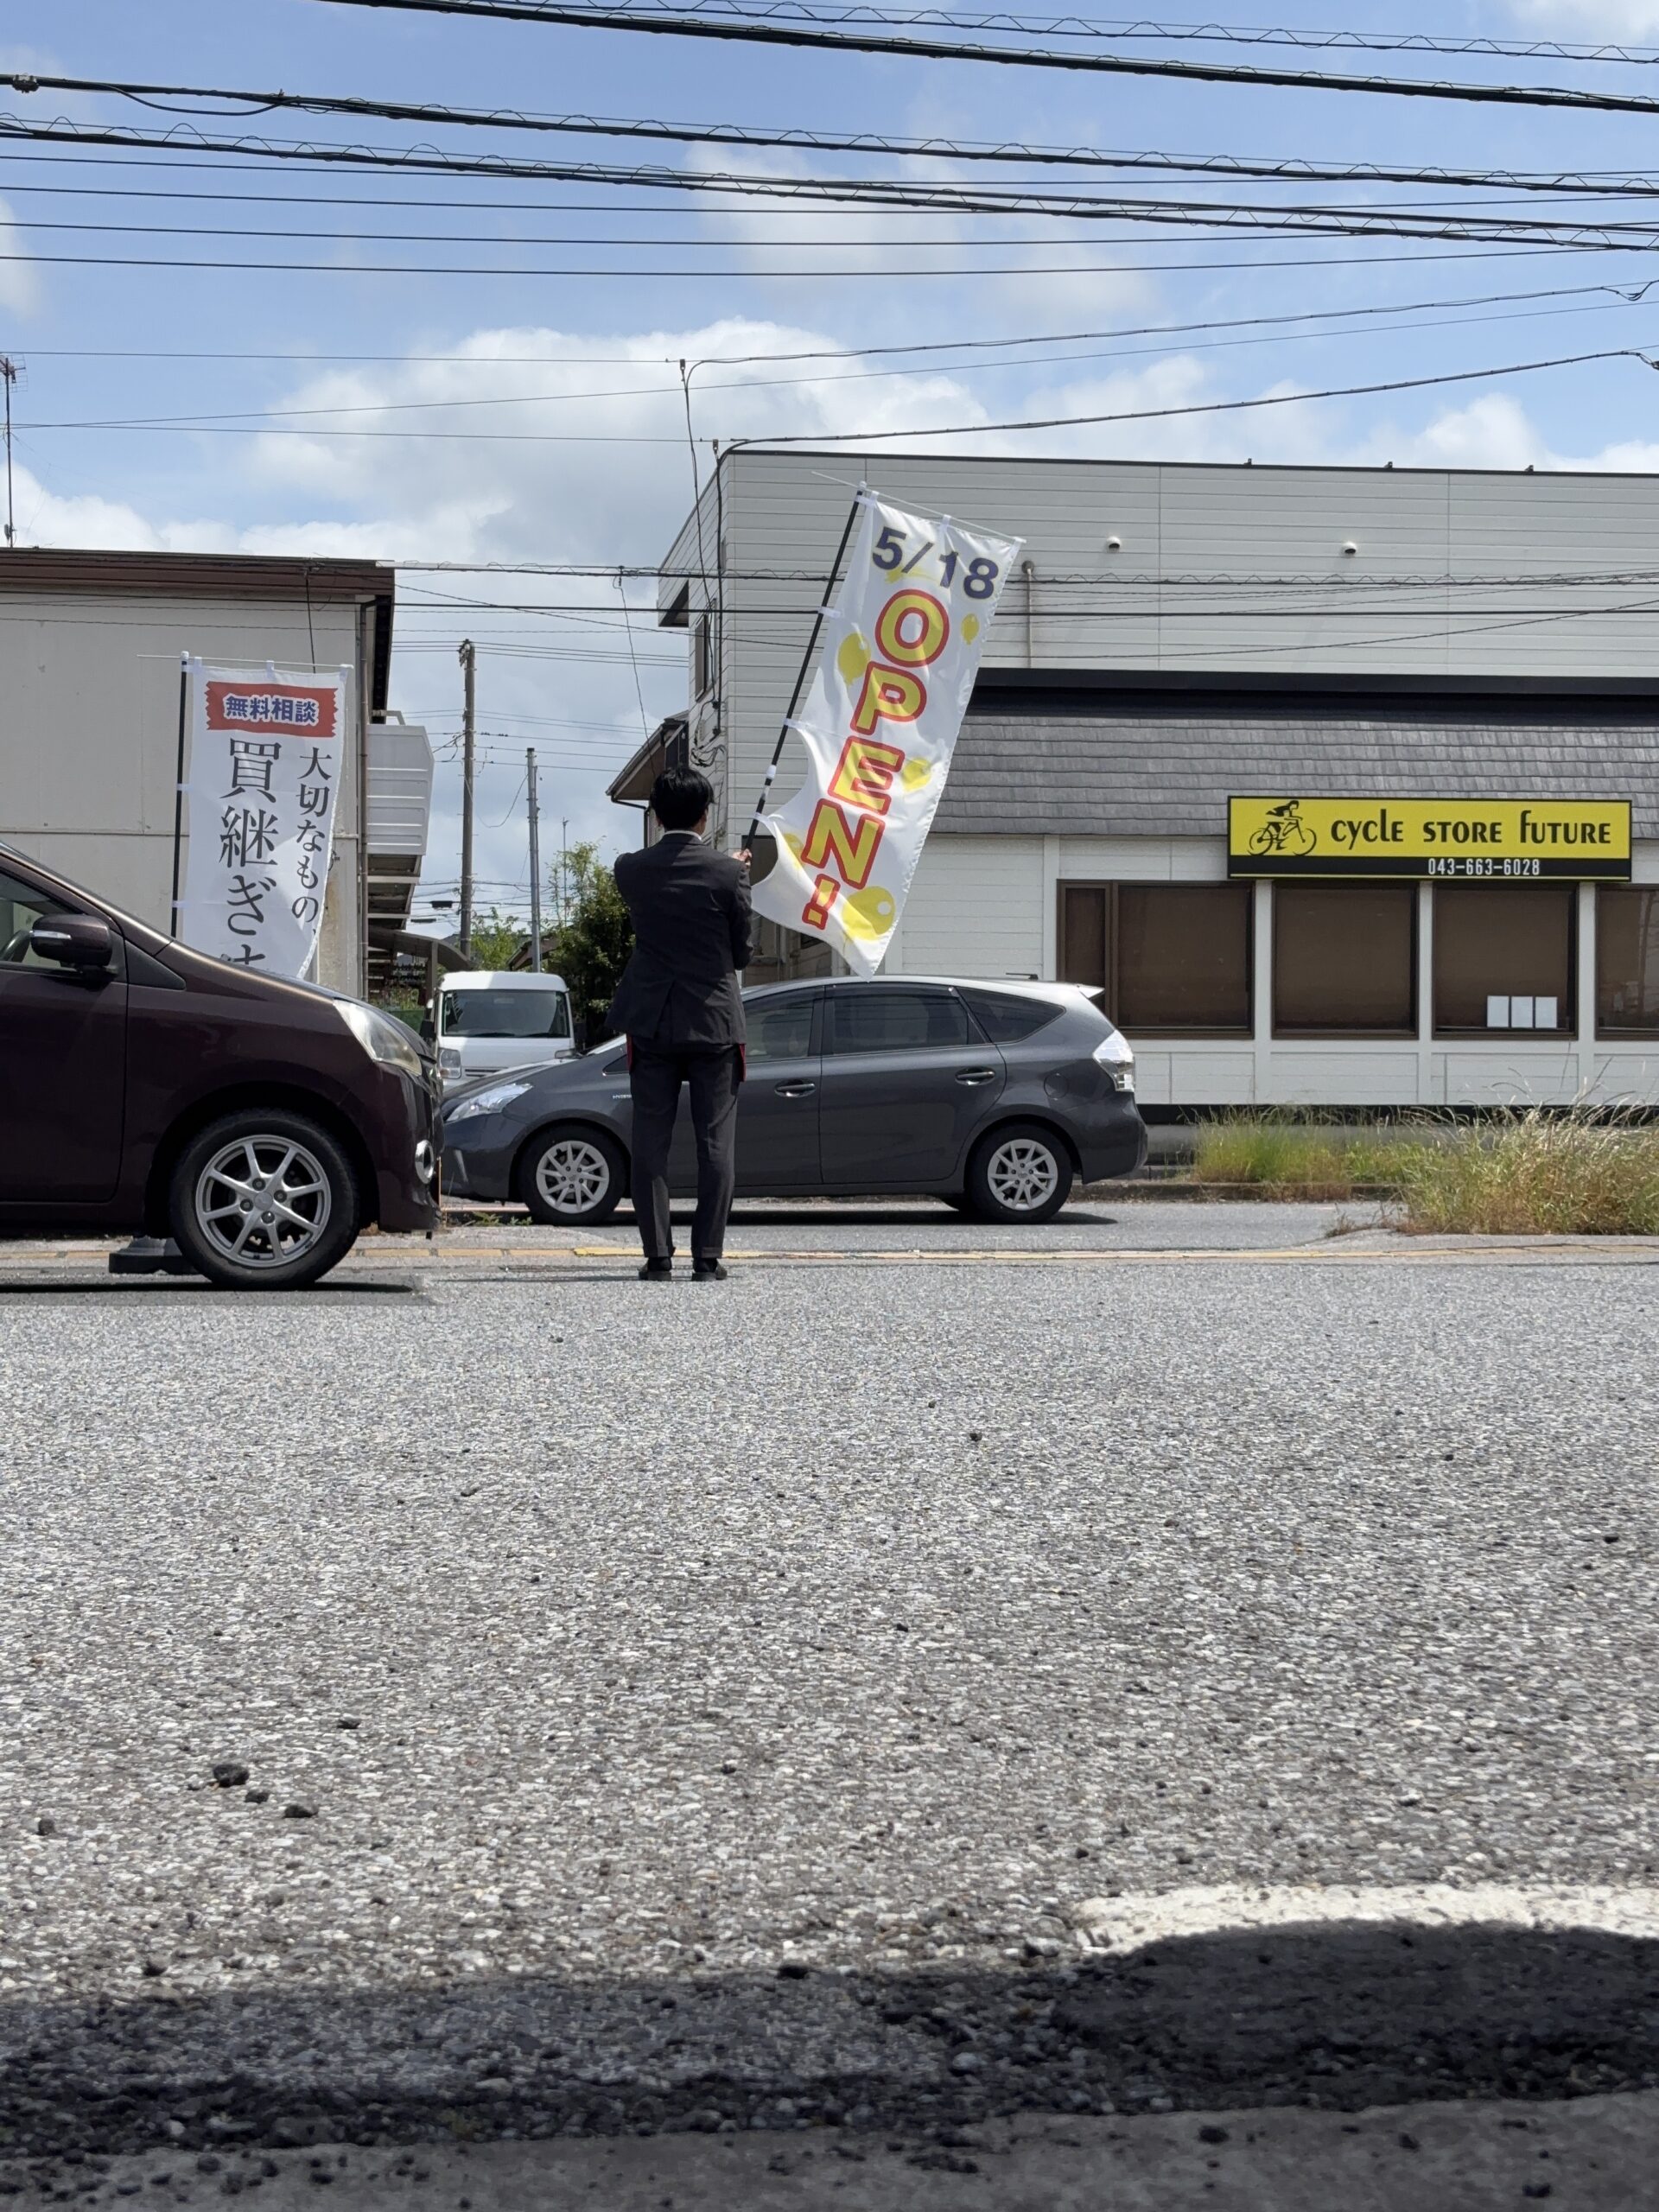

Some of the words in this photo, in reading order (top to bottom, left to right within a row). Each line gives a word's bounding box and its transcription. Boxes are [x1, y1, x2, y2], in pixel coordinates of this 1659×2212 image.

[872, 526, 1000, 600] 5/18
[224, 695, 318, 724] 無料相談
[802, 588, 950, 931] OPEN!
[1427, 857, 1541, 876] 043-663-6028
